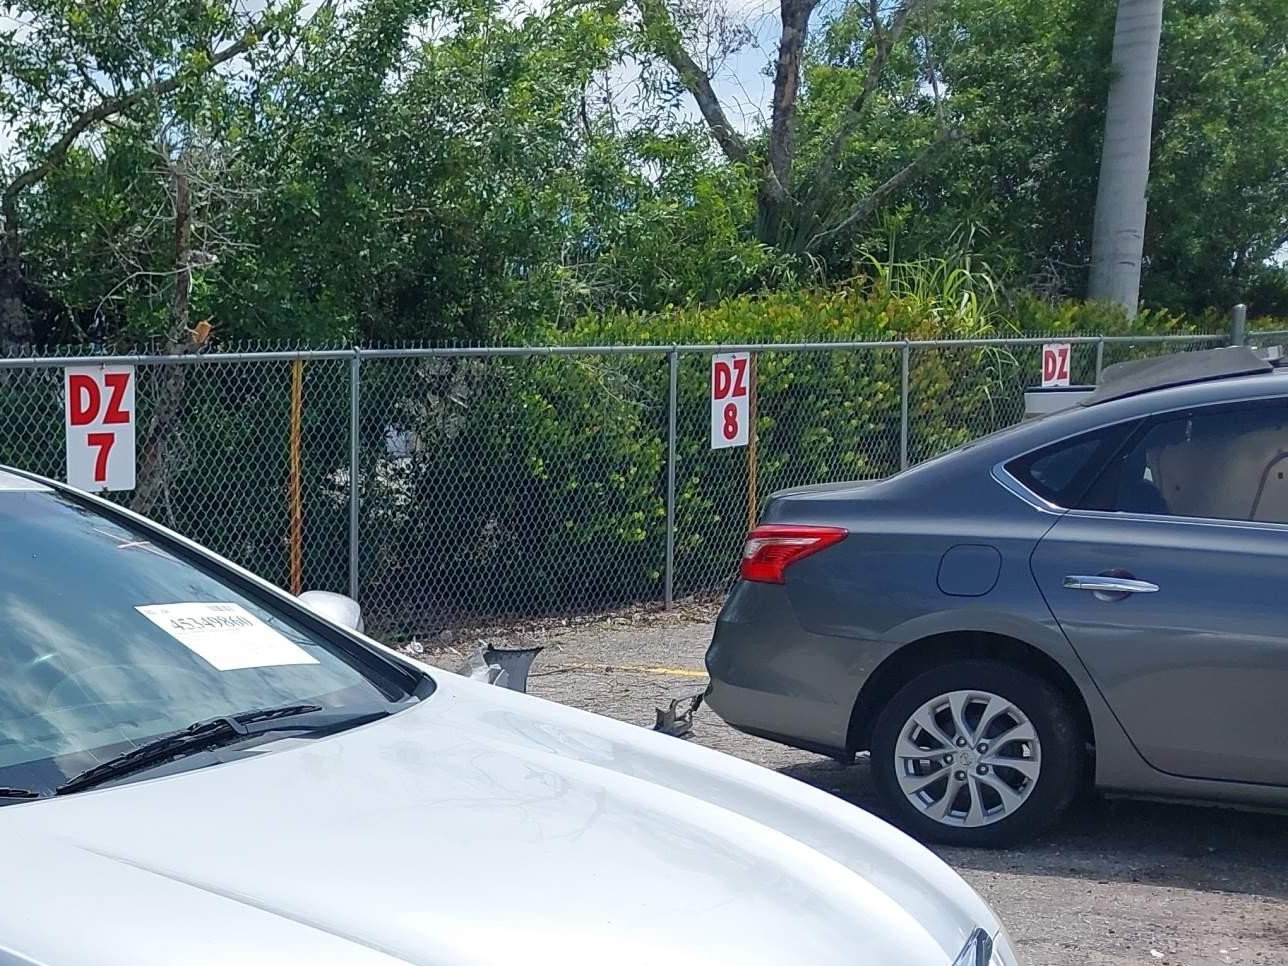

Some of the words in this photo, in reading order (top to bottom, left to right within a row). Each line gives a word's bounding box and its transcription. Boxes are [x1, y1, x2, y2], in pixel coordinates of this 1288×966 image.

[713, 357, 748, 400] DZ
[1043, 347, 1069, 382] DZ
[68, 373, 131, 426] DZ
[722, 403, 739, 440] 8
[87, 432, 116, 481] 7
